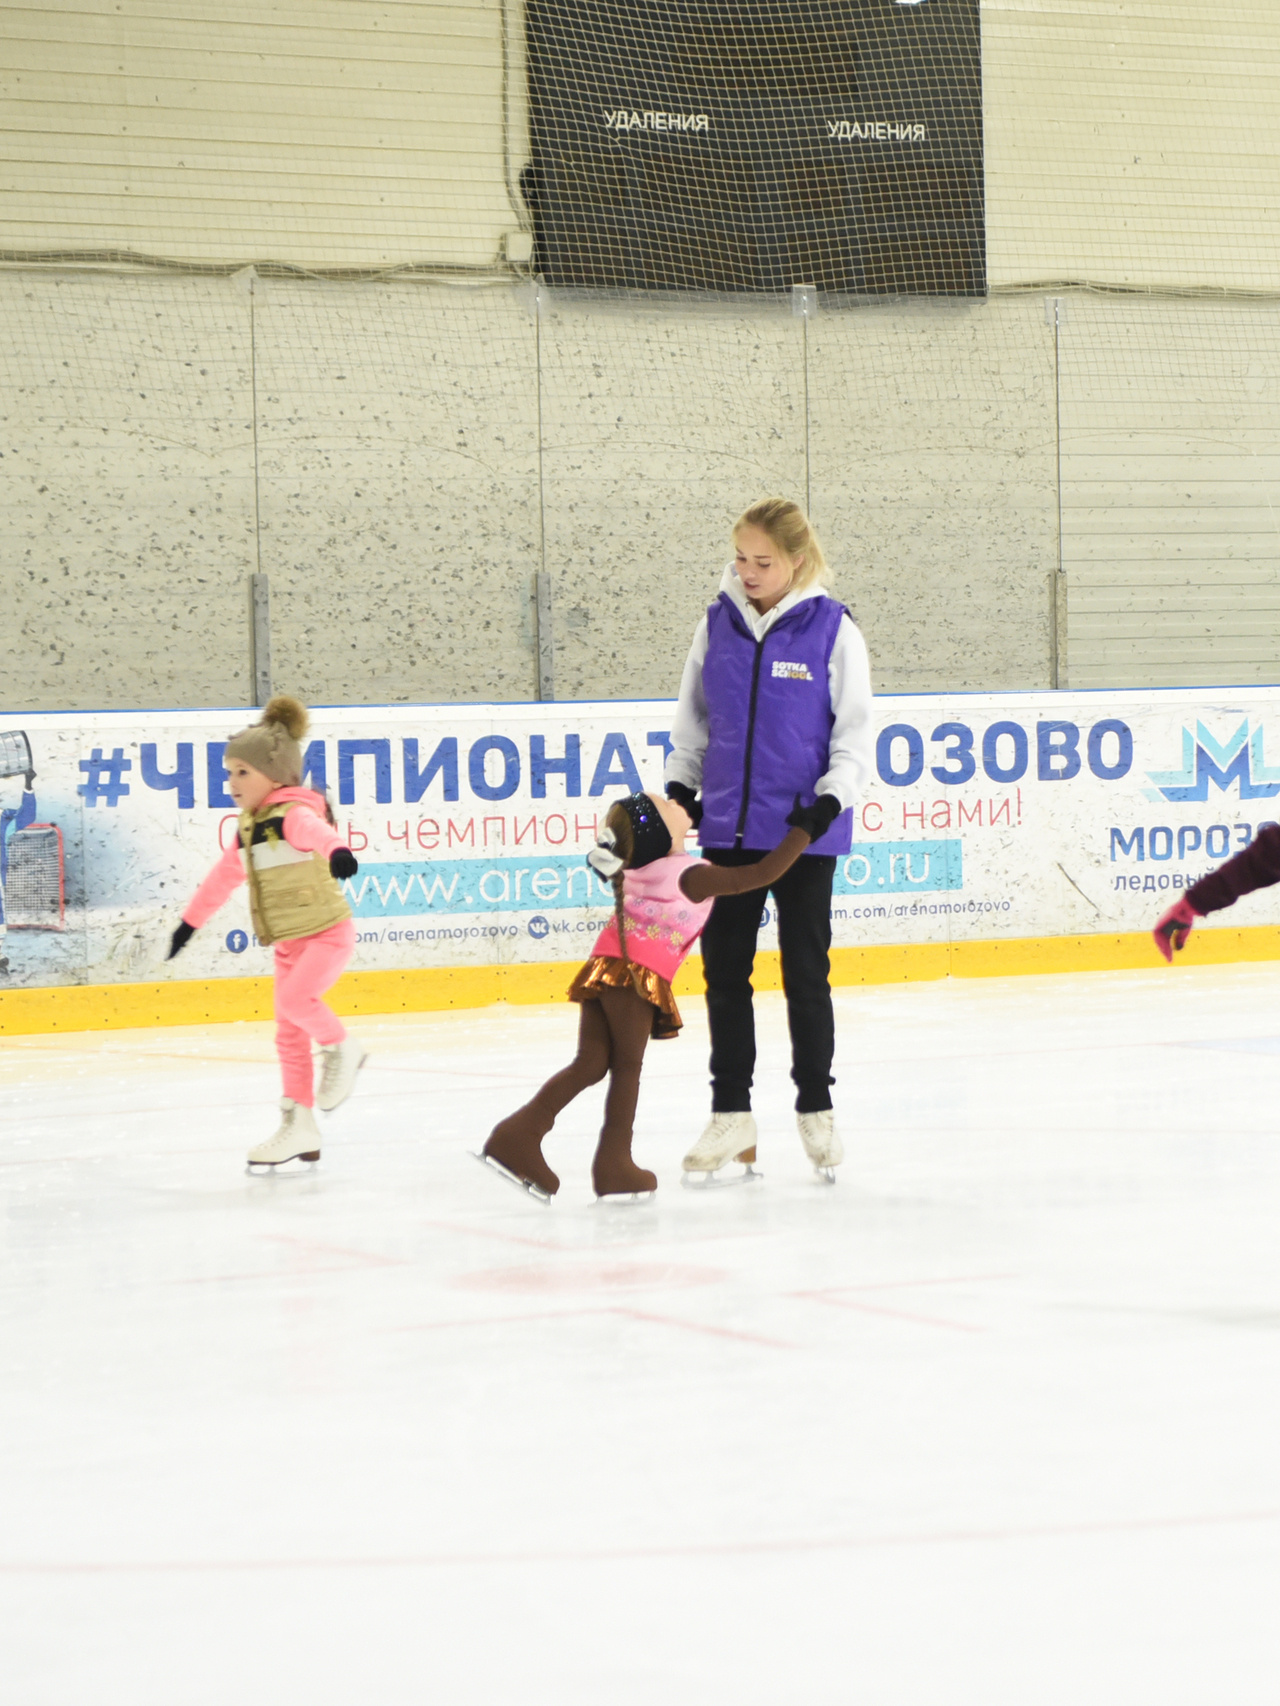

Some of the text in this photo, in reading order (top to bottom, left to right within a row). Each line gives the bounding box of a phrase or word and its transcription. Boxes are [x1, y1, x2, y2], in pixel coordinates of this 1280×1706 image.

[603, 110, 708, 131] УДАЛЕНИЯ
[827, 120, 925, 142] УДАЛЕНИЯ
[772, 661, 807, 672] SOTKA
[876, 718, 1133, 787] ОЗОВО
[387, 812, 598, 850] чемпион
[902, 788, 1023, 830] нами!
[1114, 866, 1215, 893] ледовы
